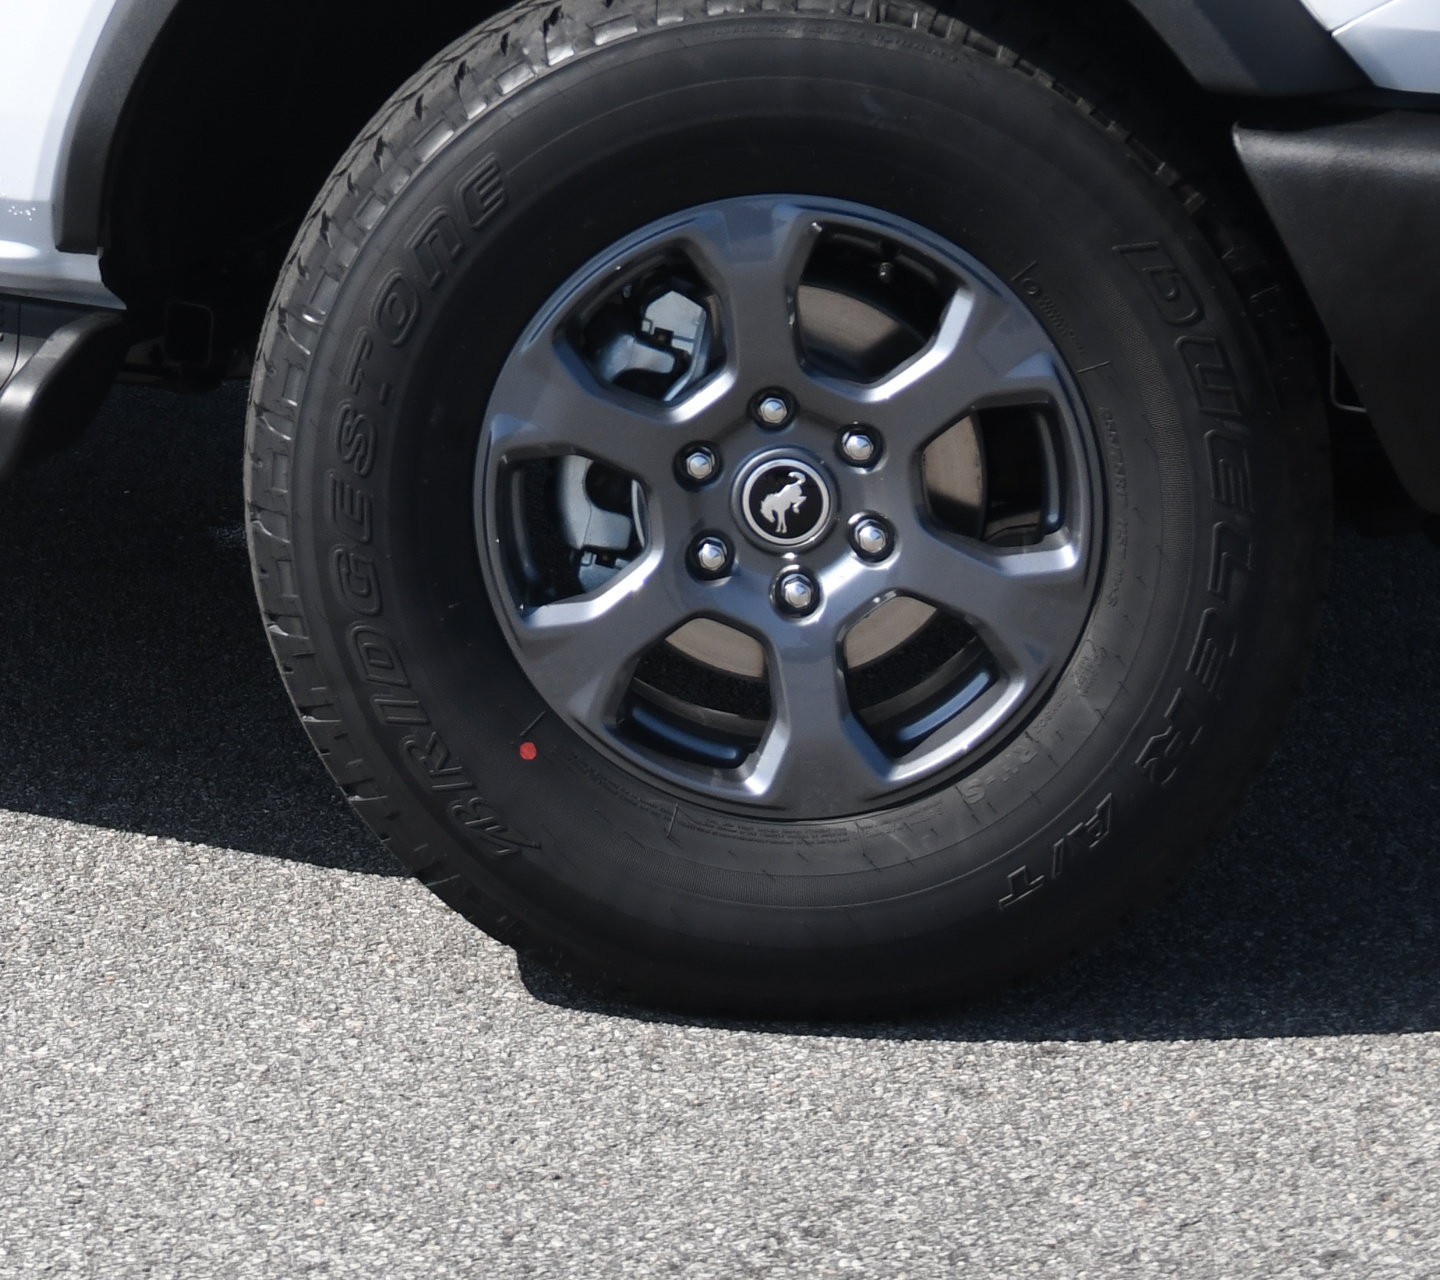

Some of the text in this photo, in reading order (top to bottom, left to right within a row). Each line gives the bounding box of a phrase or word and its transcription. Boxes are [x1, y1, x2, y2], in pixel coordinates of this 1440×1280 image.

[330, 153, 544, 858] BRIDGESTONE
[998, 239, 1252, 910] DUELER A/T
